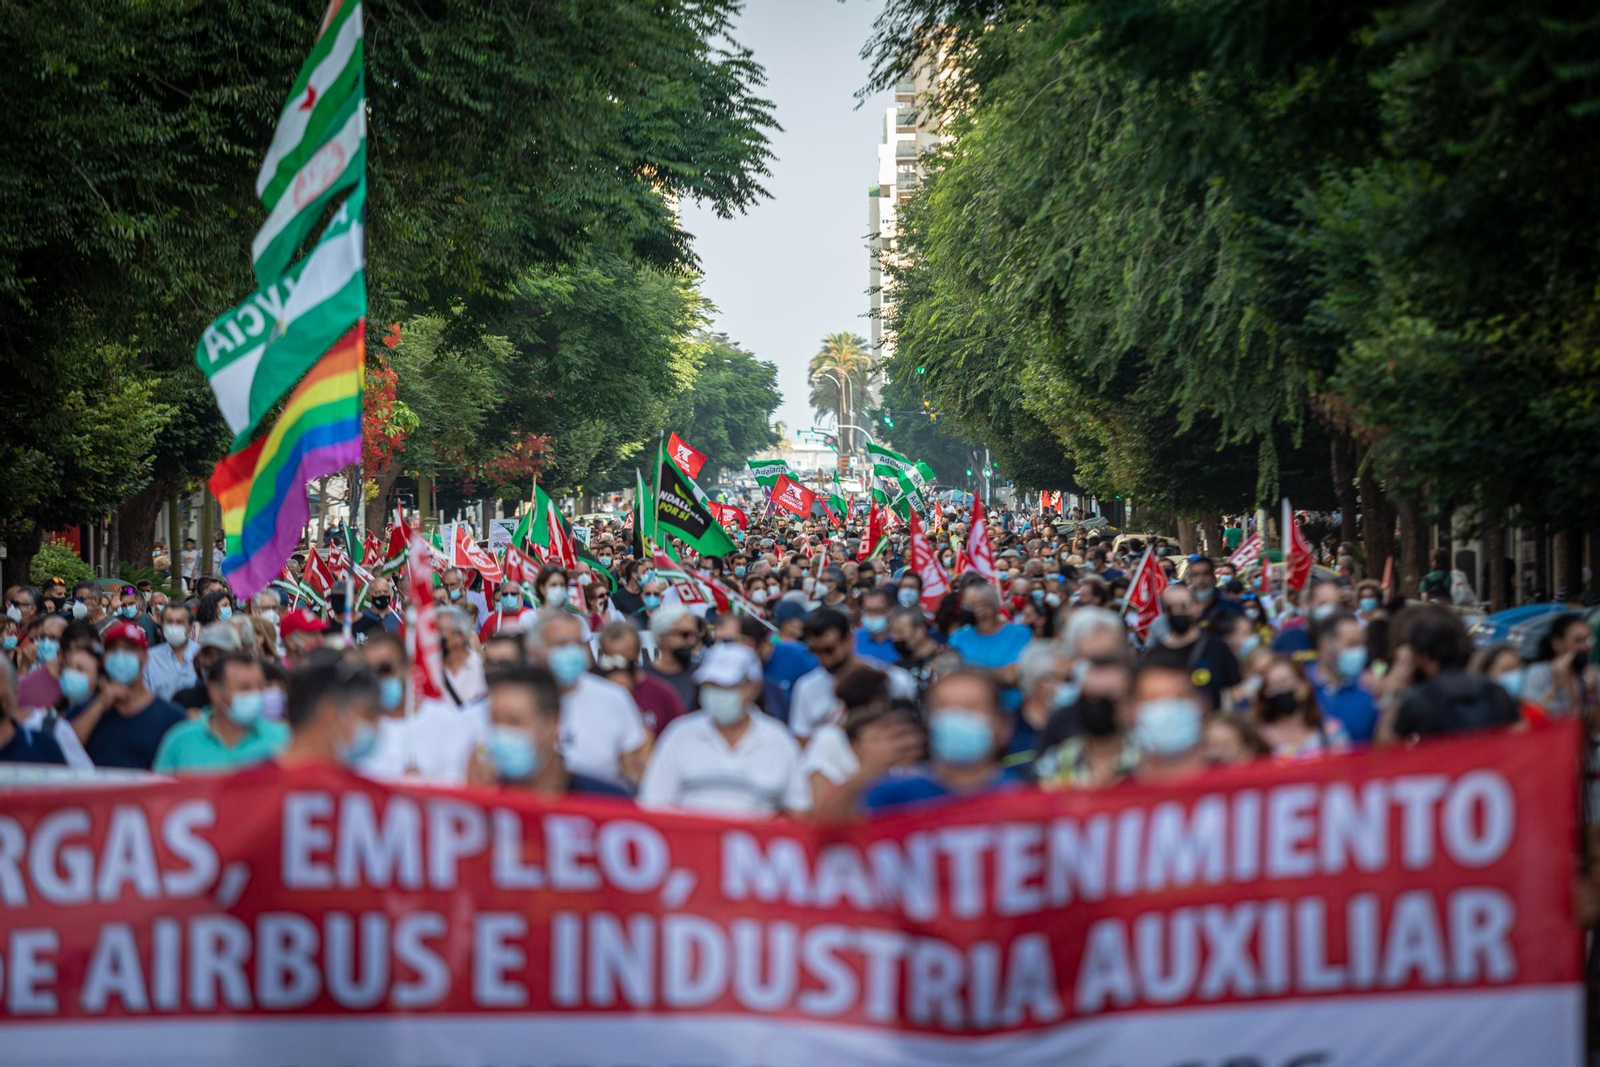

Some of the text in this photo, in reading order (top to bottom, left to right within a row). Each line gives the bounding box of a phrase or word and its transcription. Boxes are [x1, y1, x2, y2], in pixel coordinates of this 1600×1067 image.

[659, 490, 704, 525] NDALUIA
[659, 501, 679, 516] POR
[282, 792, 695, 907] EMPLEO,
[722, 770, 1514, 921] MANTENIMIENTO
[0, 888, 1516, 1030] E AIRBUS E INDUSTRIA AUXILIAR
